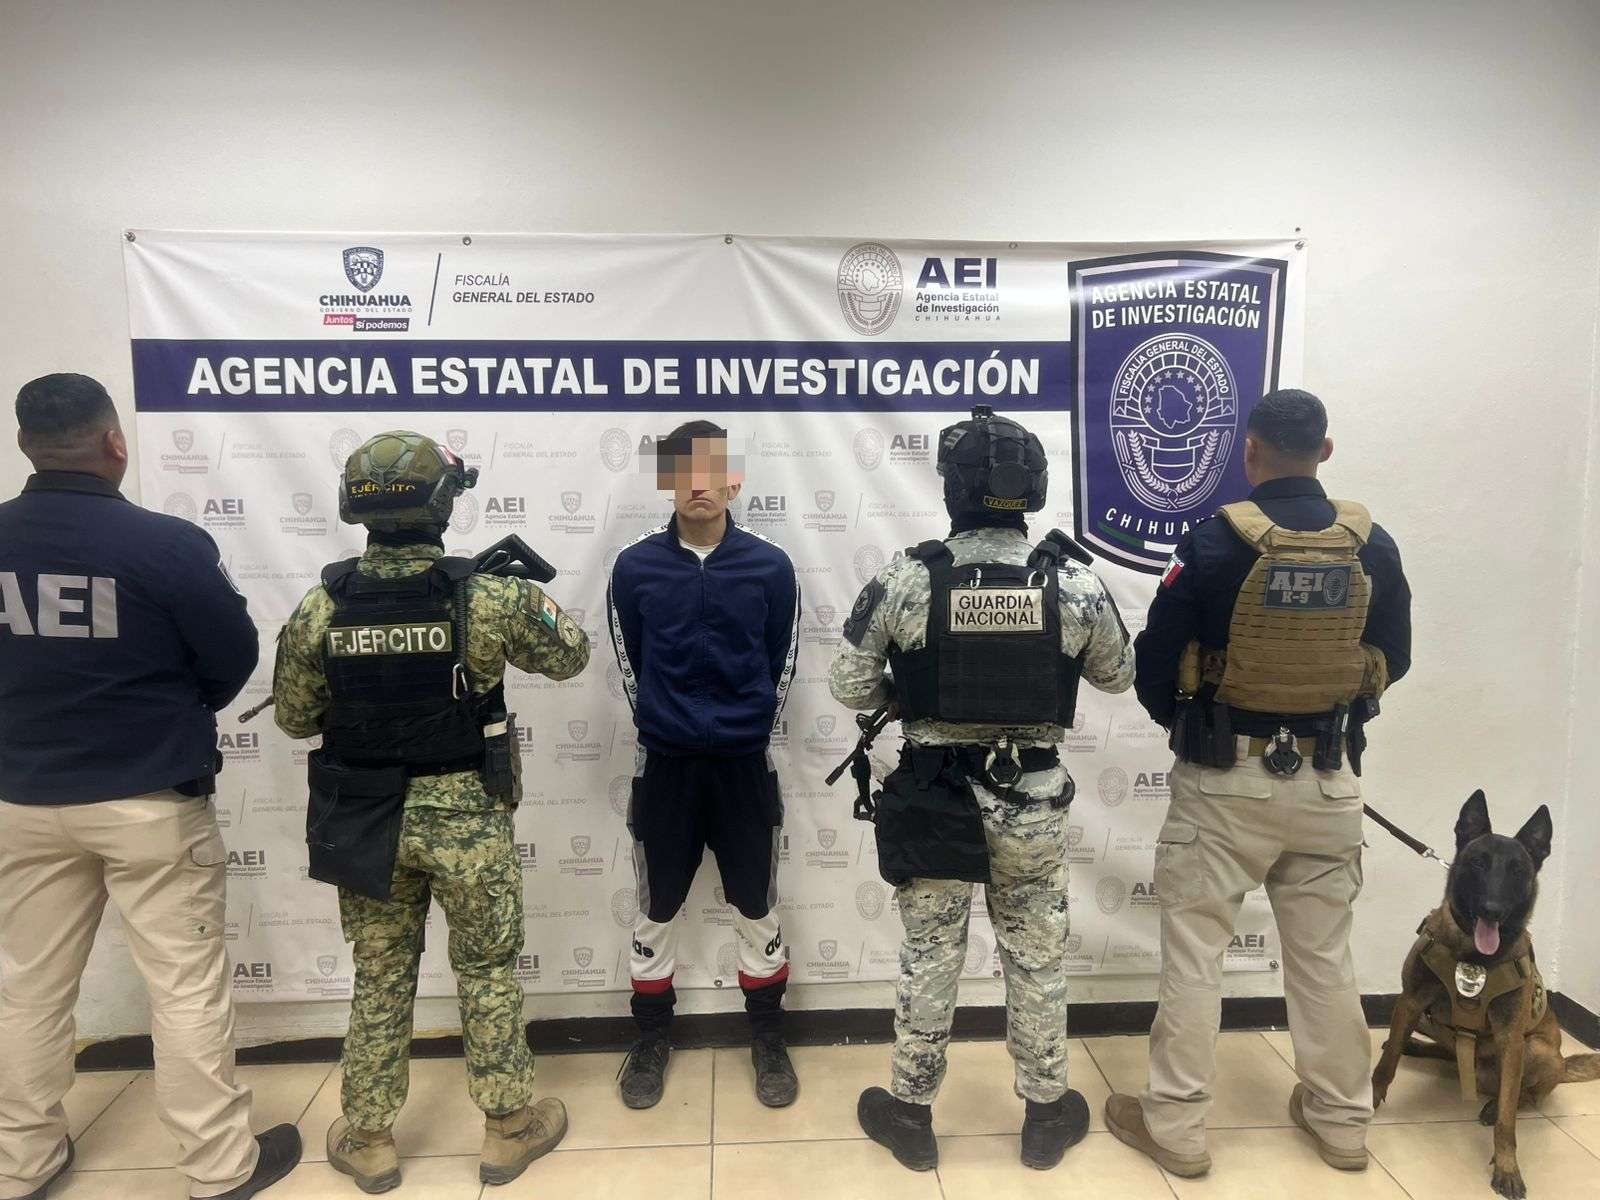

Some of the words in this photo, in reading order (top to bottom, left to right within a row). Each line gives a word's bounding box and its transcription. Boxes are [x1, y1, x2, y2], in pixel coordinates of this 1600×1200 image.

[455, 272, 510, 286] FISCALÍA
[916, 258, 997, 288] AEI
[452, 291, 512, 303] GENERAL
[516, 291, 540, 303] DEL
[544, 292, 595, 303] ESTADO
[916, 292, 959, 303] Agencia
[962, 292, 999, 302] Estatal
[1092, 281, 1177, 304] AGENCIA
[1184, 279, 1261, 305] ESTATAL
[319, 295, 411, 306] CHIHUAHUA
[916, 304, 928, 312] de
[931, 303, 999, 314] Investigación
[1092, 308, 1115, 329] DE
[1121, 303, 1261, 329] INVESTIGACIÓN
[325, 315, 354, 324] Juntos
[365, 320, 408, 330] podemos
[187, 356, 397, 395] AGENCIA
[411, 357, 608, 395] ESTATAL
[623, 357, 680, 395] DE
[696, 350, 1039, 395] INVESTIGACIÓN
[1120, 354, 1148, 395] FISCALÍA
[1146, 340, 1190, 357] GENERAL
[1191, 344, 1207, 361] DEL
[1206, 357, 1229, 393] ESTADO
[890, 434, 929, 449] AEI
[203, 499, 244, 514] AEI
[485, 497, 525, 512] AEI
[747, 496, 786, 511] AEI
[1105, 508, 1200, 535] CHIHUA
[1269, 572, 1325, 591] AEI
[959, 595, 1033, 610] GUARDIA
[955, 611, 1038, 626] NACIONAL
[329, 627, 446, 654] EJÉRCITO
[218, 733, 258, 748] AEI
[515, 843, 535, 857] EI
[226, 851, 265, 866] AEI
[1132, 883, 1157, 895] AE
[1228, 935, 1264, 947] AEI
[517, 955, 539, 969] EI
[232, 963, 272, 978] AEI
